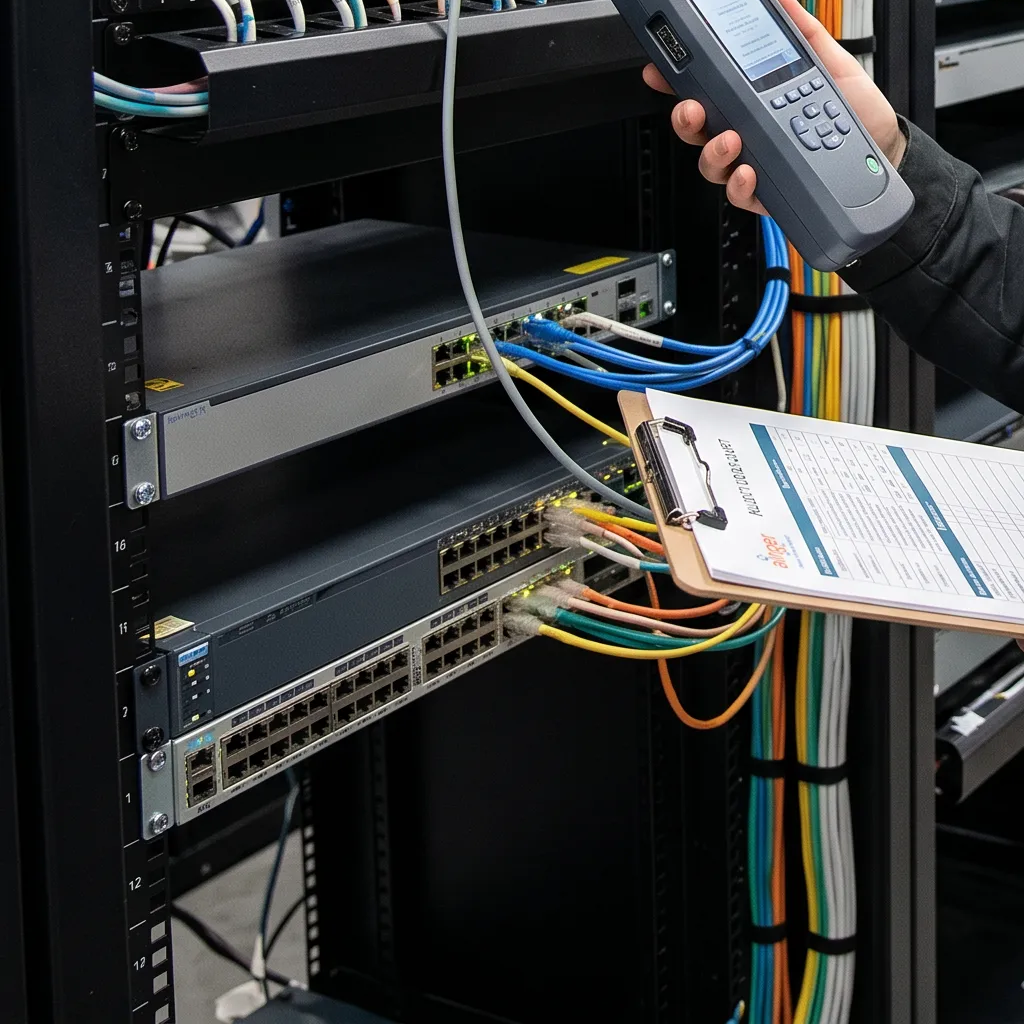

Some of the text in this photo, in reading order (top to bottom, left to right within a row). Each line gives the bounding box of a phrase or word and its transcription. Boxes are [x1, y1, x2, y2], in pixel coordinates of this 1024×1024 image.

[114, 539, 126, 552] 16
[125, 792, 132, 804] 1
[129, 876, 142, 891] 12
